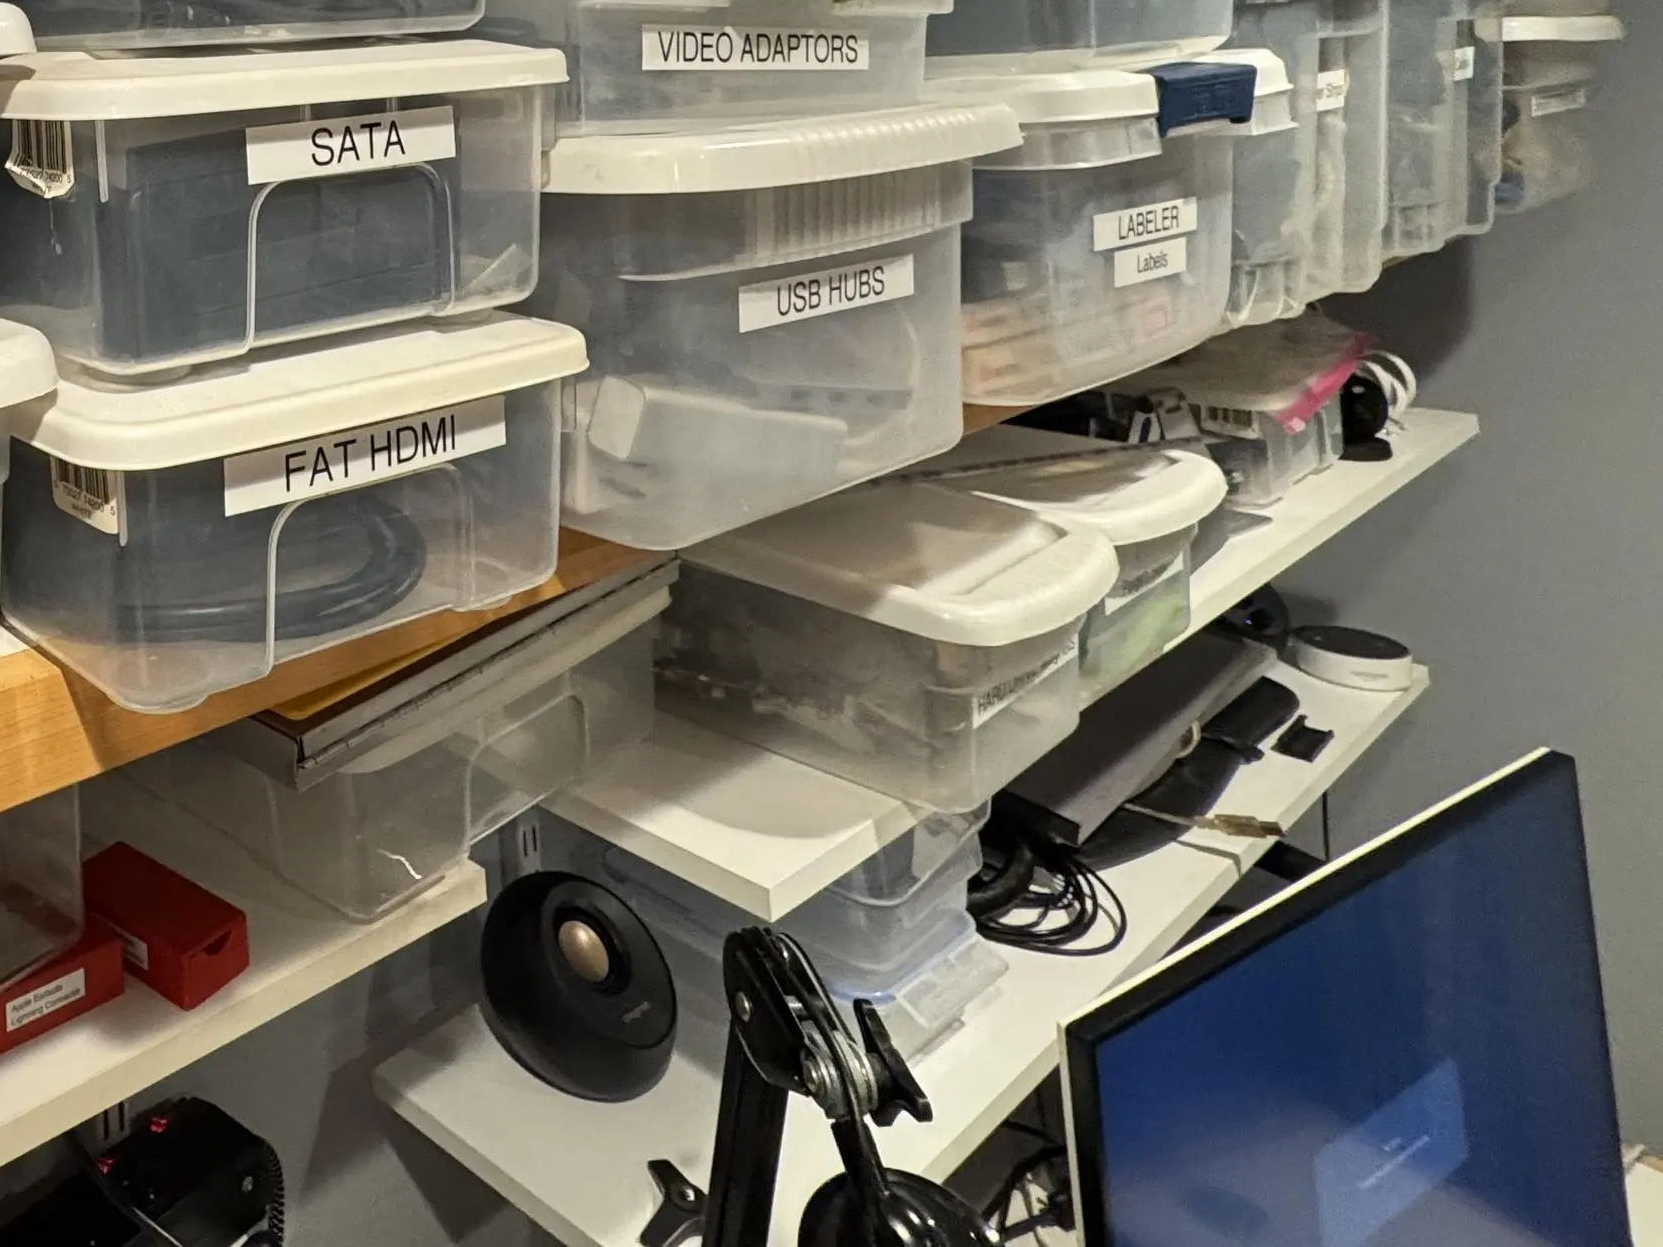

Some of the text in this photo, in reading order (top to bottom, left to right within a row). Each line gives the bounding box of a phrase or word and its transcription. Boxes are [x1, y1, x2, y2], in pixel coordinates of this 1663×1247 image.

[658, 31, 858, 64] VIDEO ADAPTORS
[312, 120, 406, 166] SATA
[1118, 205, 1180, 241] LABELER
[1137, 251, 1168, 274] Labels
[776, 267, 885, 317] USB HUBS
[285, 414, 456, 492] FAT HDMI
